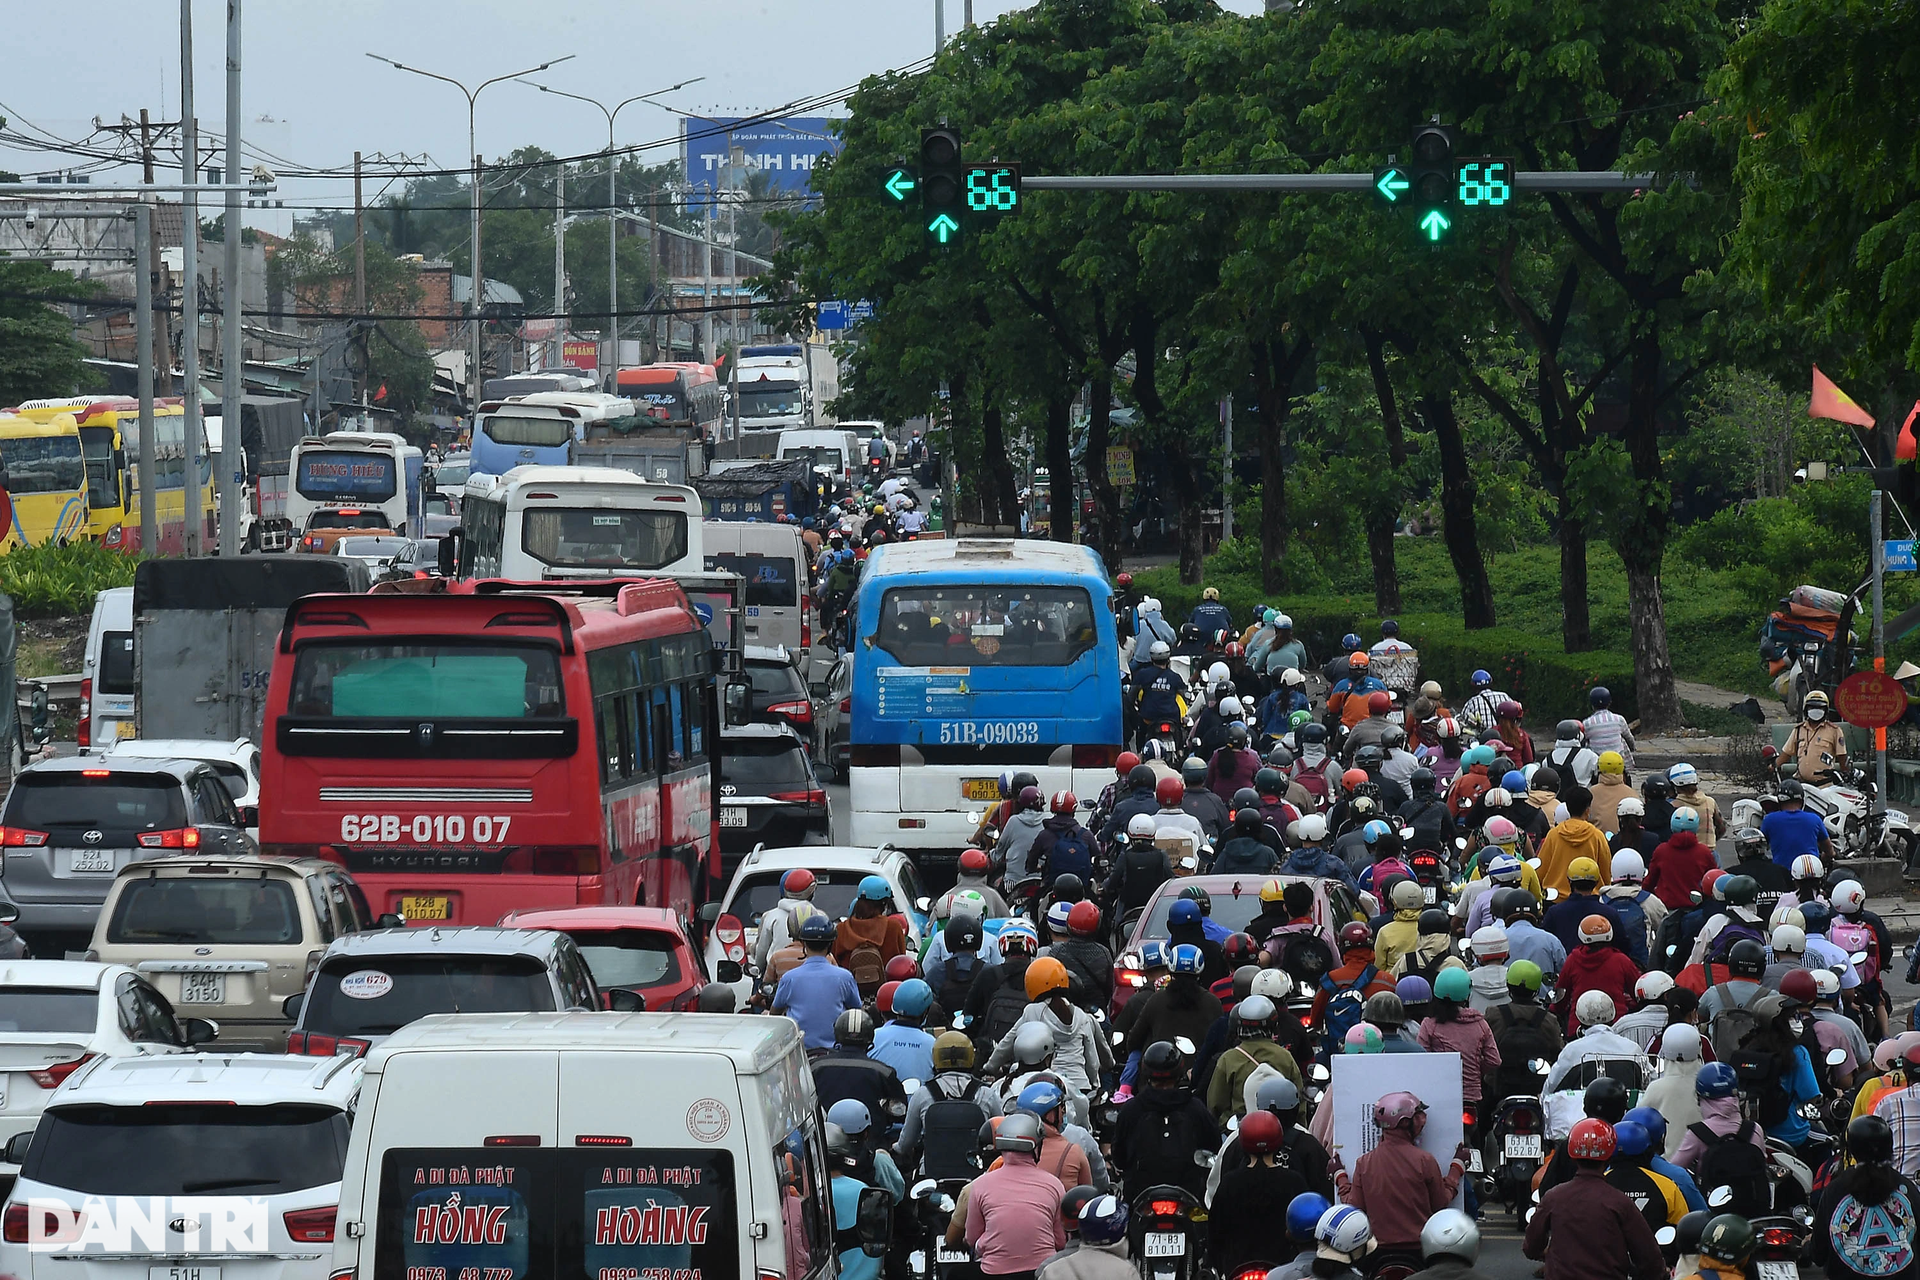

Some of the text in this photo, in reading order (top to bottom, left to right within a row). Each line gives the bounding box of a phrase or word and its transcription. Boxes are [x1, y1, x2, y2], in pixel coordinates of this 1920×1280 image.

[967, 169, 1016, 210] 66
[1459, 163, 1509, 205] 66
[940, 721, 1039, 743] 51B-09033
[414, 896, 435, 908] 62B
[366, 975, 387, 984] 679
[185, 988, 220, 1001] 3150
[414, 1165, 515, 1187] A DI ĐÀ PHẬT
[601, 1165, 702, 1188] A DI ĐÀ PHẬT
[173, 1219, 197, 1231] KIA
[413, 1192, 511, 1244] HỒNG
[595, 1198, 711, 1245] HOÀNG
[169, 1268, 201, 1280] 51H
[406, 1266, 447, 1280] 0973
[483, 1267, 514, 1280] 772
